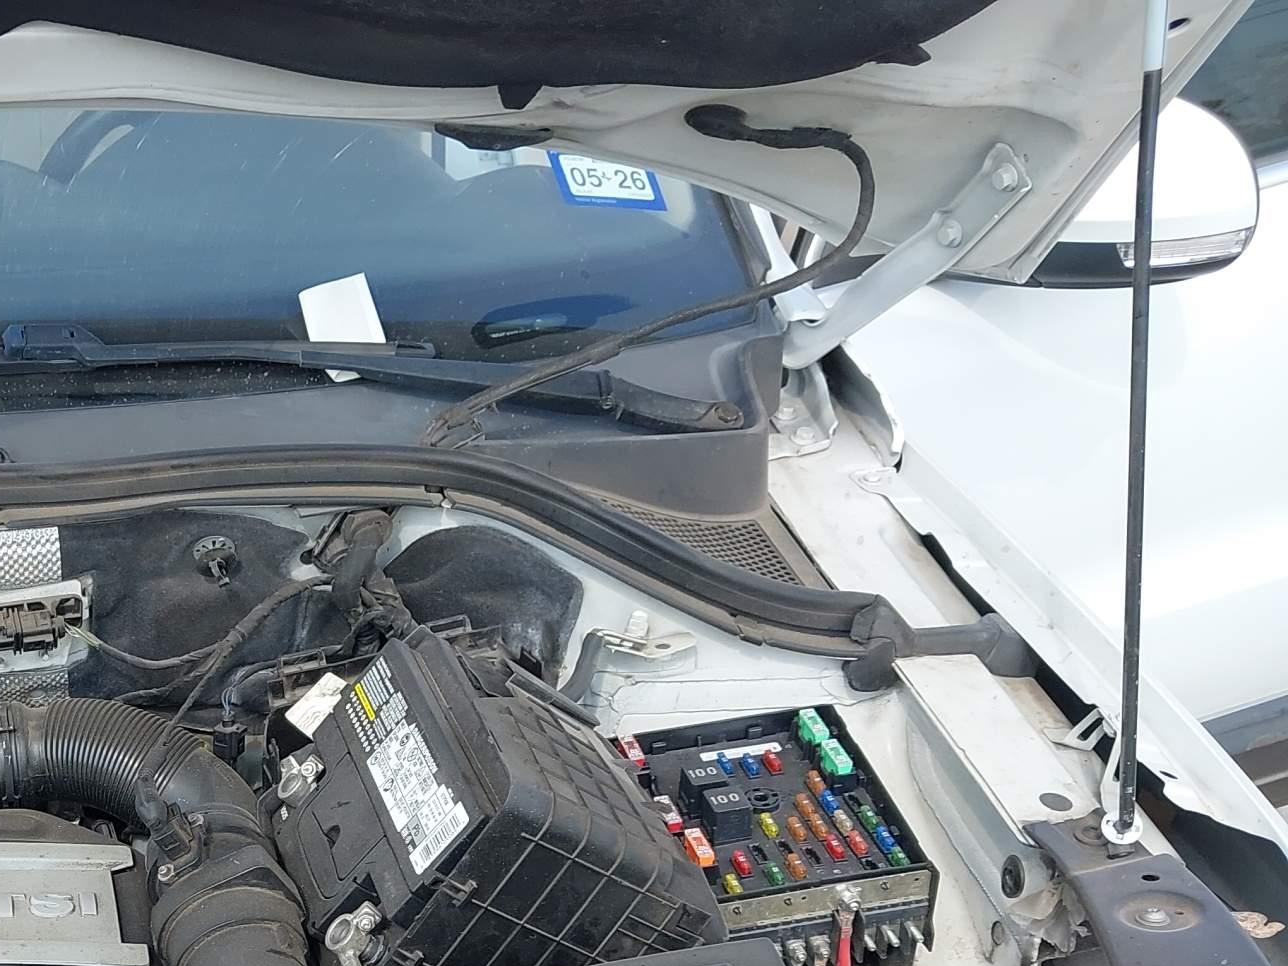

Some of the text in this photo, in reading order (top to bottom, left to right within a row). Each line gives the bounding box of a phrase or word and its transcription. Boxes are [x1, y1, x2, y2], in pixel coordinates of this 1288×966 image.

[570, 167, 646, 191] 05 26
[688, 766, 717, 779] 100
[710, 793, 740, 806] 100
